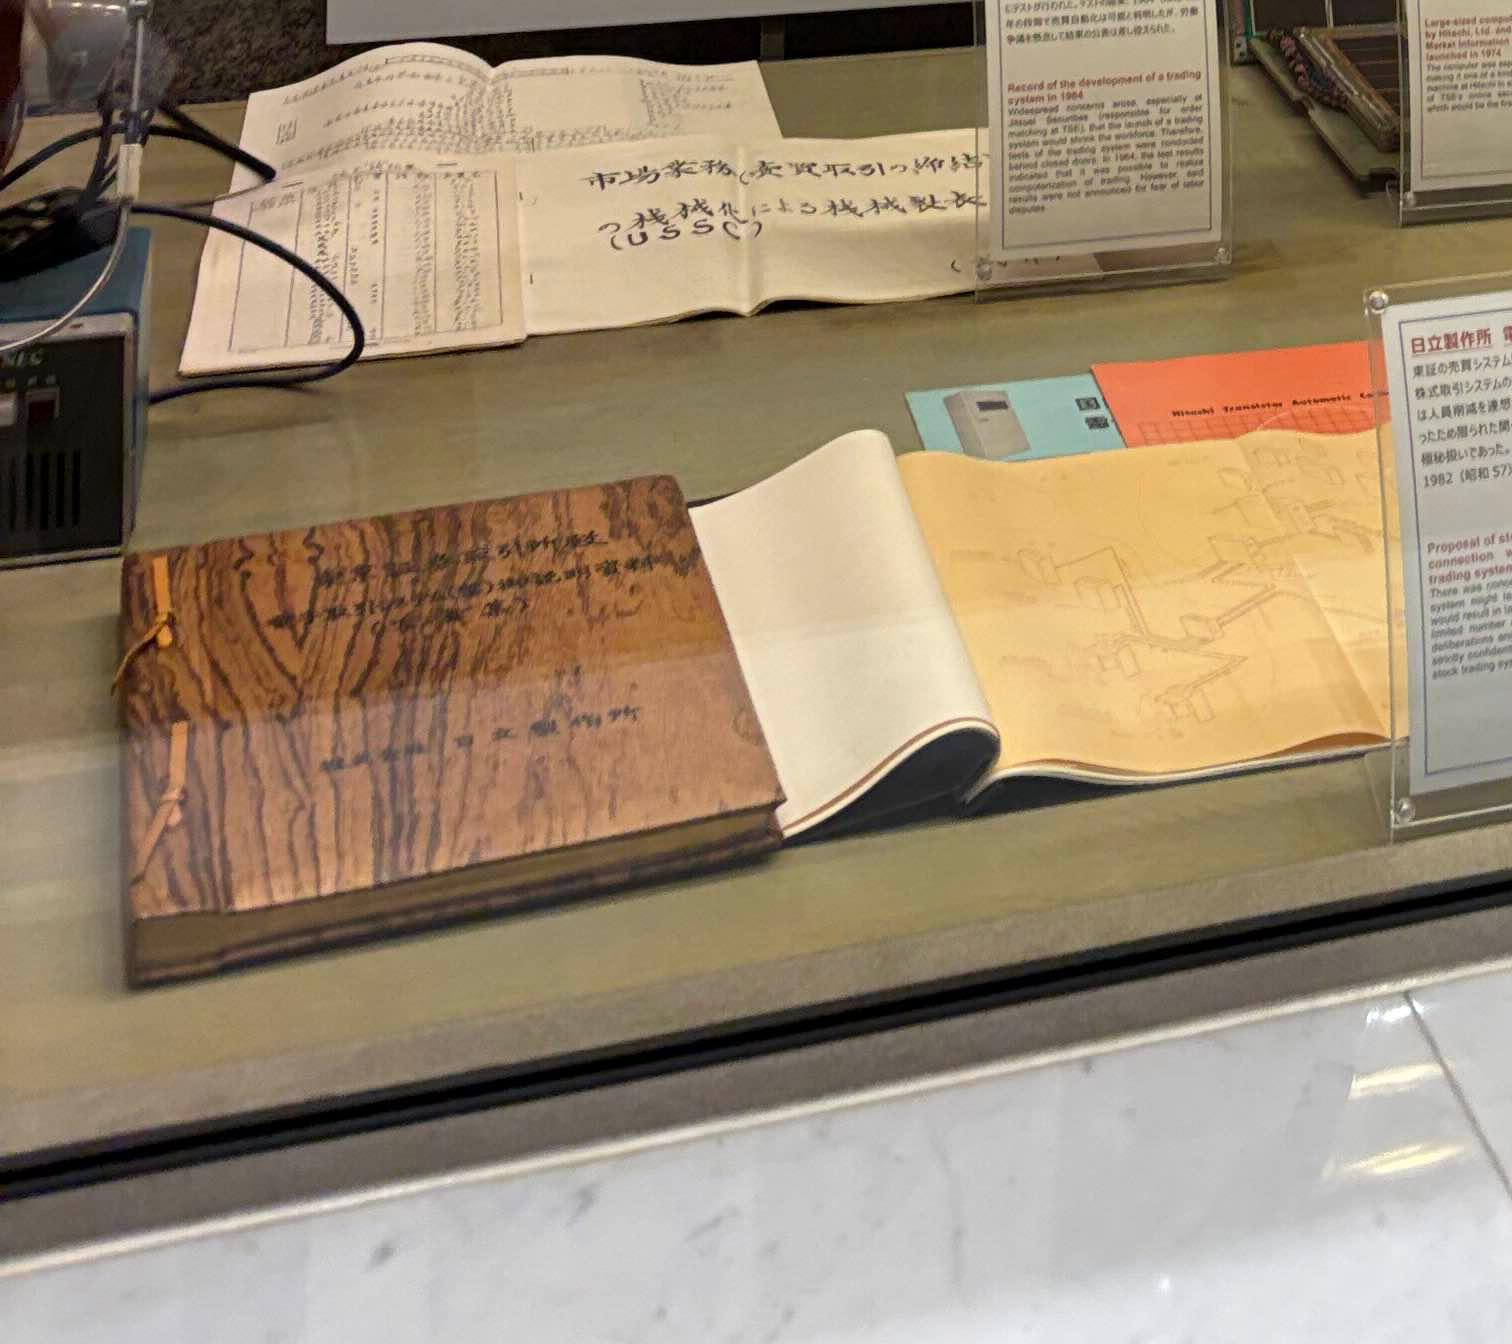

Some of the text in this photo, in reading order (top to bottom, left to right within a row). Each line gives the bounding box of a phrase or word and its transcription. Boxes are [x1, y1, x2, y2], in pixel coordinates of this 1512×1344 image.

[1410, 327, 1492, 356] 日立製作所
[1427, 536, 1481, 555] Proposal
